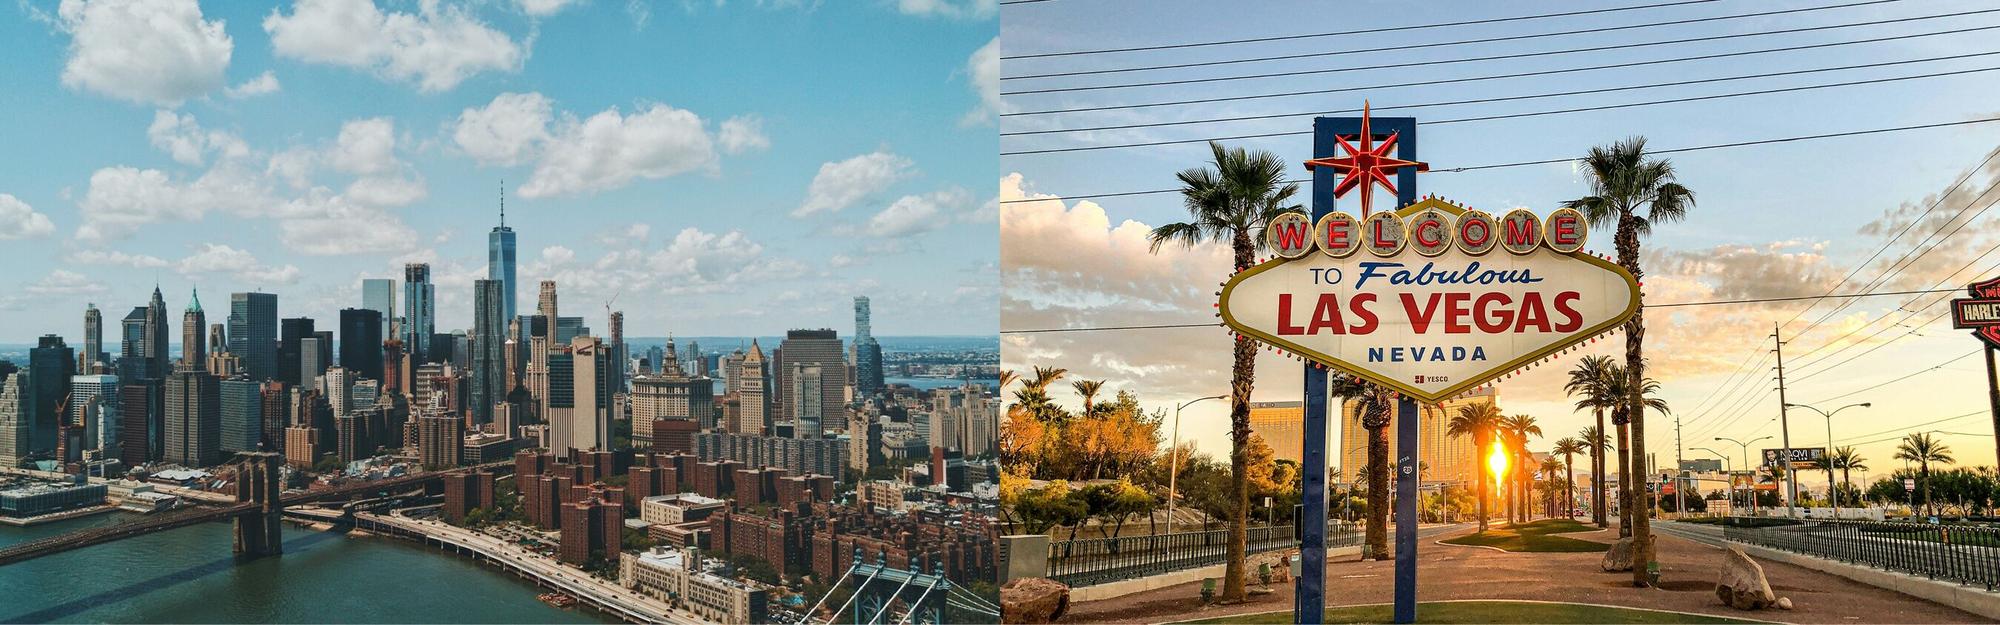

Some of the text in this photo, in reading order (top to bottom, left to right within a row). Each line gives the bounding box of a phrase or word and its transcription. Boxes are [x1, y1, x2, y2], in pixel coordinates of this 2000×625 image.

[1275, 217, 1577, 250] WELCOME
[1309, 261, 1544, 290] TO Fabulous
[1277, 290, 1584, 336] LAS VEGAS
[1963, 303, 2000, 321] HARLE
[1368, 345, 1488, 363] NEVADA
[1426, 375, 1449, 383] YESCO
